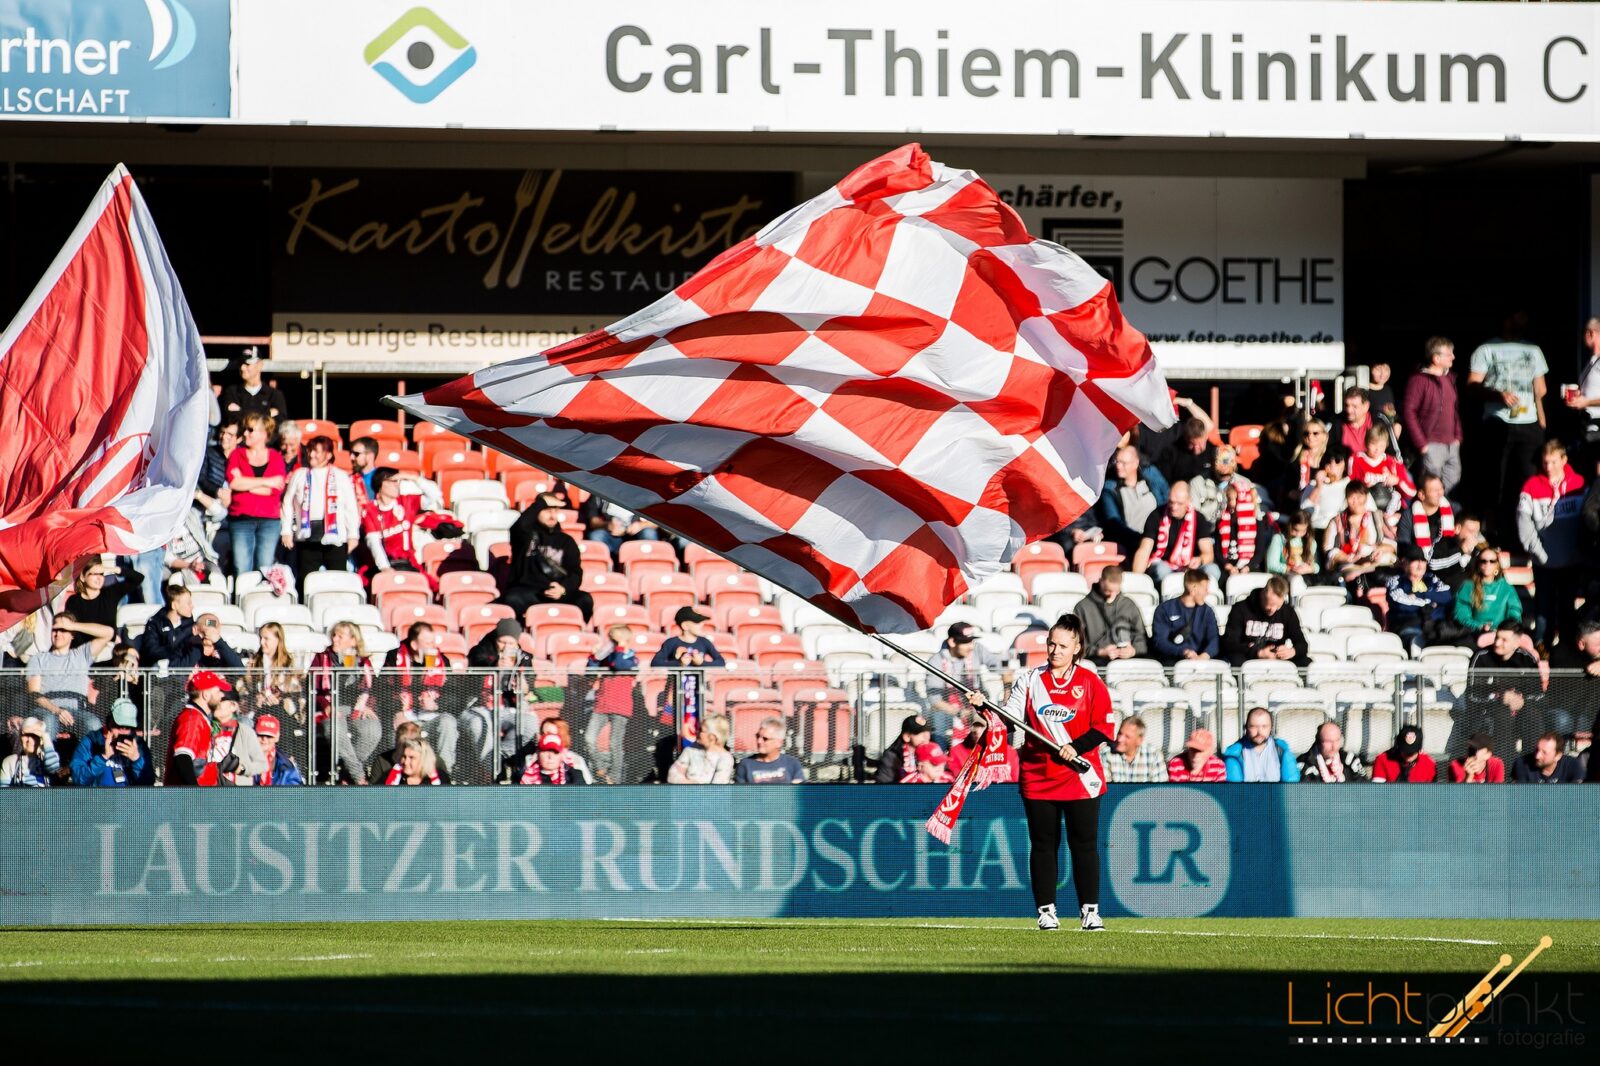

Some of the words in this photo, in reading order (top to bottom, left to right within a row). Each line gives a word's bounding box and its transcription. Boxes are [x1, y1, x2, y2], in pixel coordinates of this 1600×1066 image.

[605, 24, 1507, 103] Carl-Thiem-Klinikum
[1543, 35, 1588, 103] C
[0, 87, 130, 114] LSCHAFT
[1129, 255, 1336, 305] GOETHE
[286, 322, 337, 347] Das
[347, 323, 417, 353] urige
[1044, 708, 1068, 718] envia
[94, 821, 550, 898] LAUSITZER
[1131, 821, 1210, 885] LR
